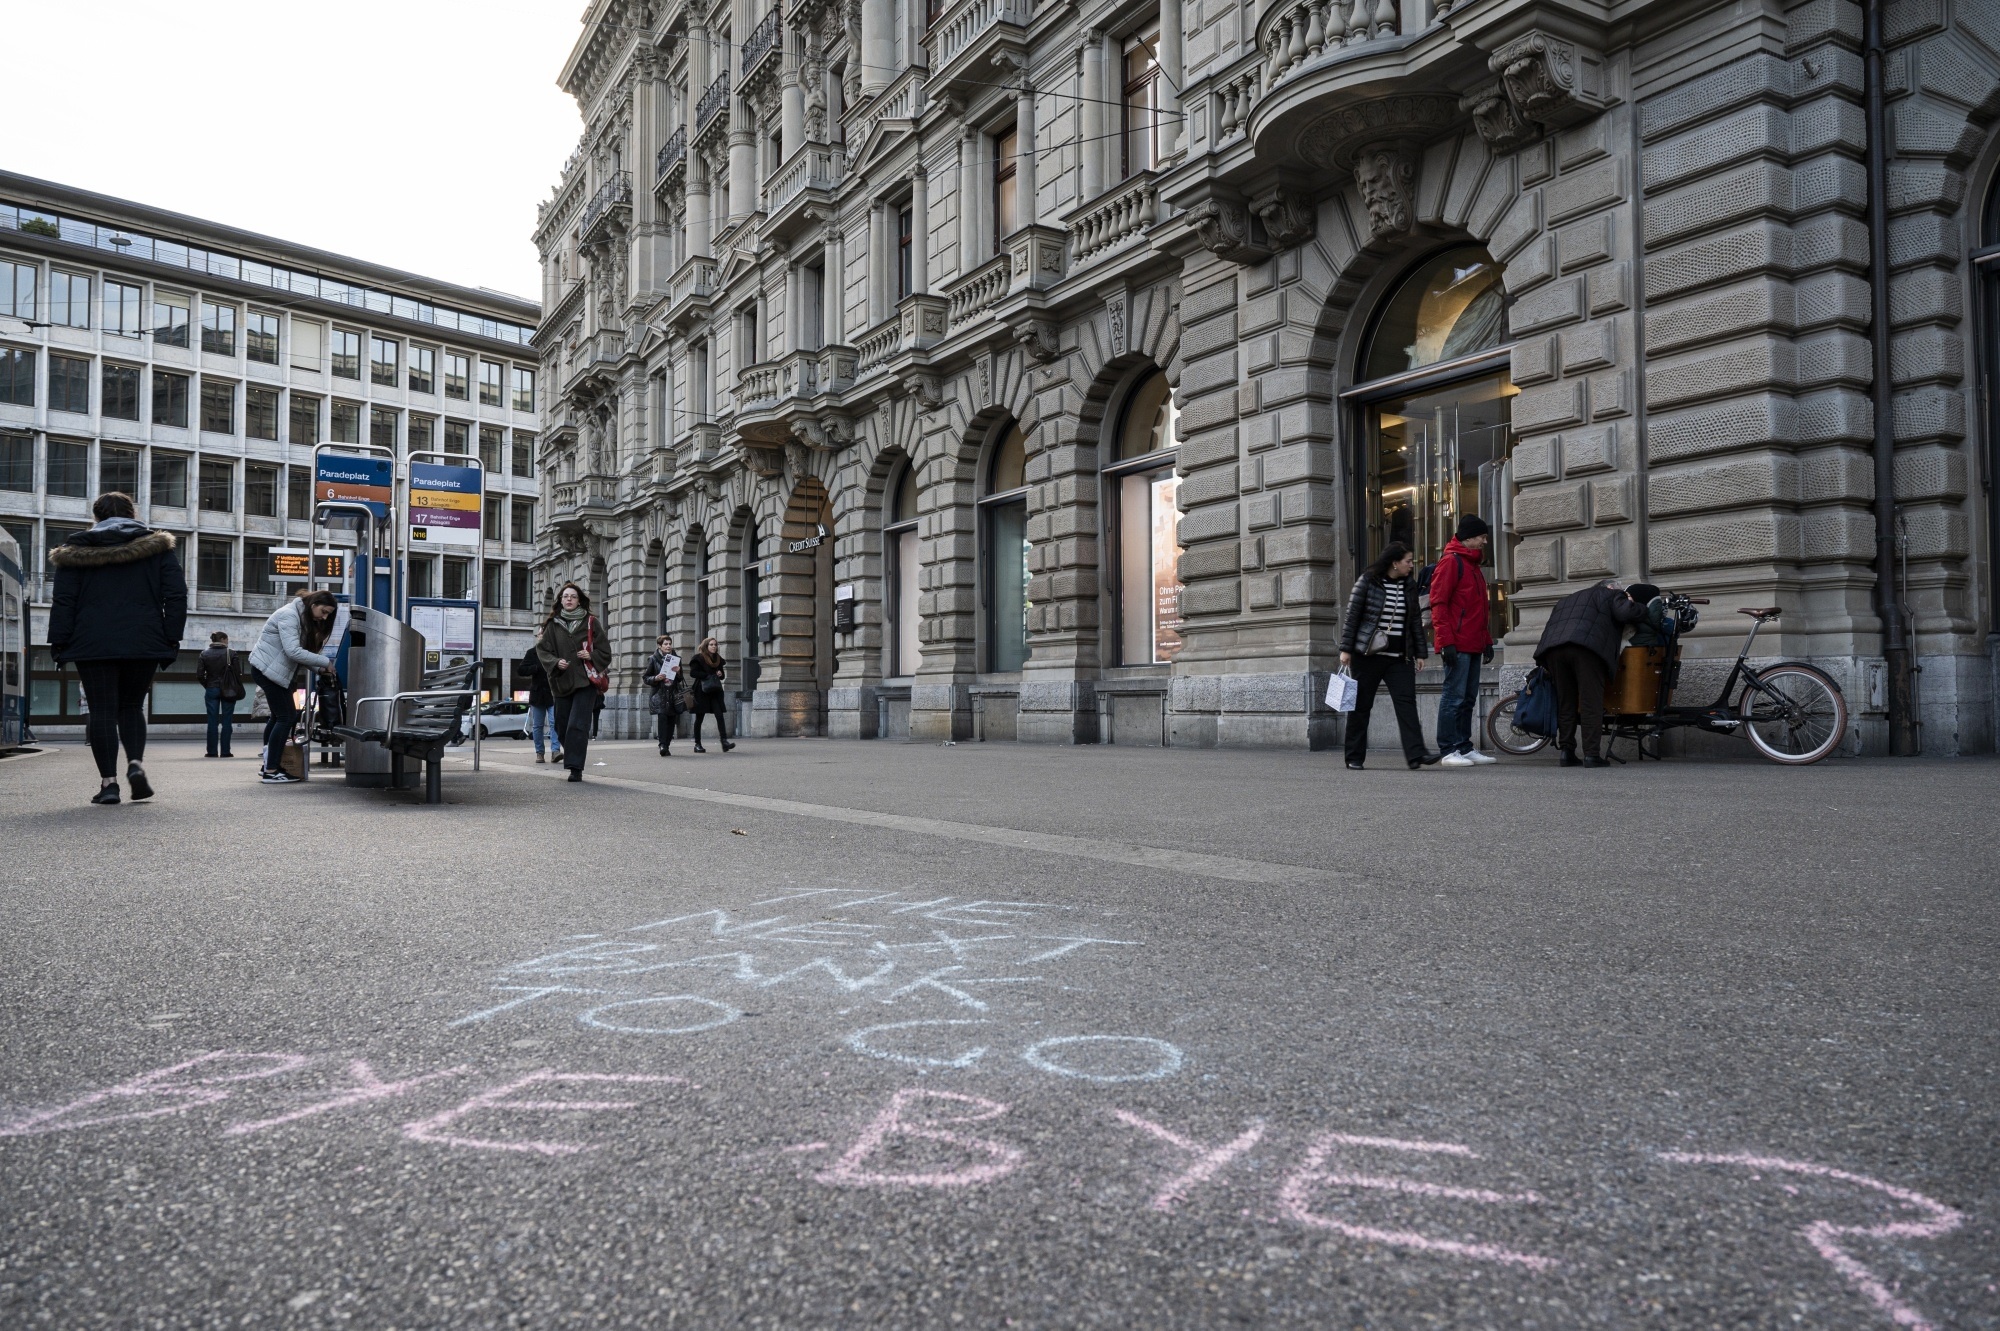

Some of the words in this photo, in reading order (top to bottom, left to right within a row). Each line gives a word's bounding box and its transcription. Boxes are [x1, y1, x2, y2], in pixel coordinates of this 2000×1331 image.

[320, 469, 370, 480] Paradeplatz
[413, 477, 460, 488] Paradeplatz
[327, 488, 335, 499] 6
[416, 496, 429, 506] 13
[415, 513, 428, 524] 17
[413, 531, 426, 539] N16
[1159, 586, 1174, 595] Ohne
[1159, 597, 1171, 606] zum
[1159, 607, 1175, 615] Warum
[750, 887, 1072, 926] THE
[625, 909, 1146, 966] NEXT
[500, 937, 1044, 1012] BANK
[446, 984, 744, 1034] TO
[847, 1018, 1185, 1082] GO
